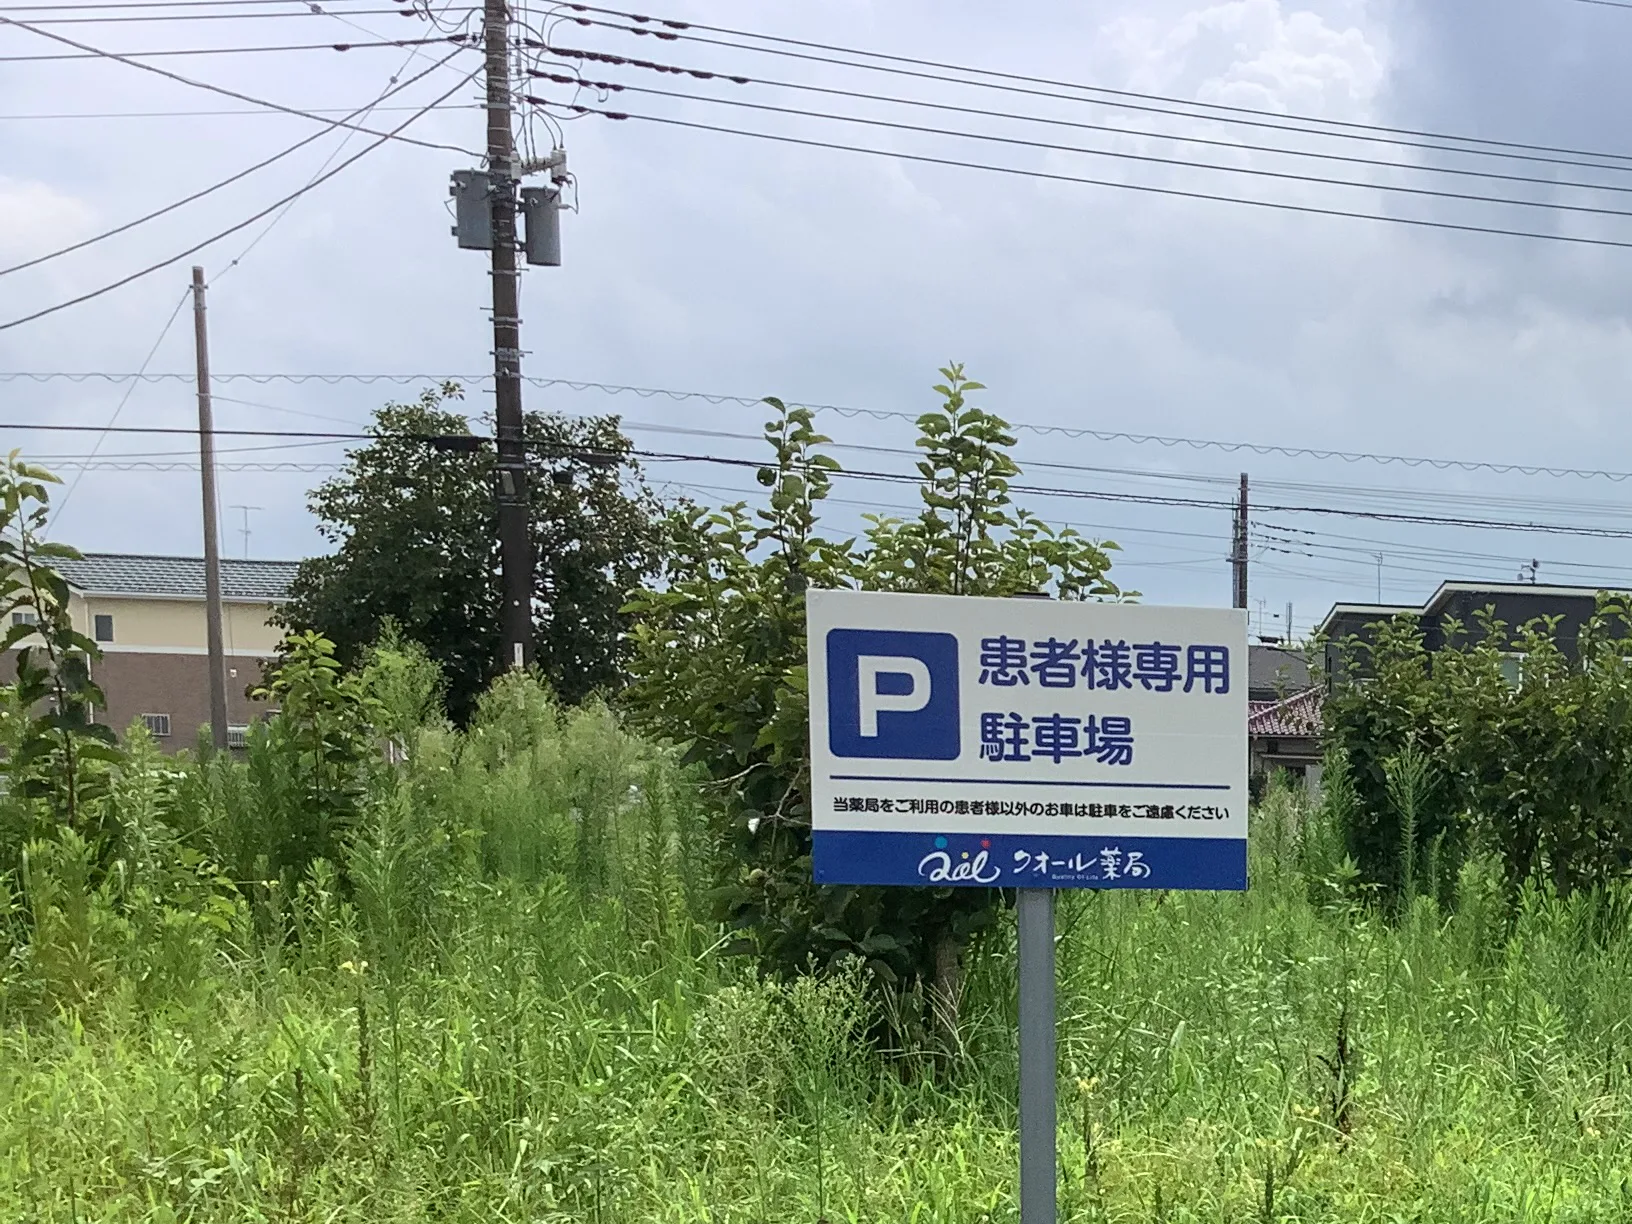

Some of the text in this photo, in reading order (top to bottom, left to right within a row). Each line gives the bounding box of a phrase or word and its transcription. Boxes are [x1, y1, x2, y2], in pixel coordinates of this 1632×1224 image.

[979, 635, 1231, 695] 患者様専用
[858, 655, 932, 738] P
[980, 712, 1134, 766] 駐車場
[833, 797, 1230, 820] 当薬局をご利用の患者様以外のお車は駐車をご遠慮ください
[1013, 846, 1151, 880] クオール薬局
